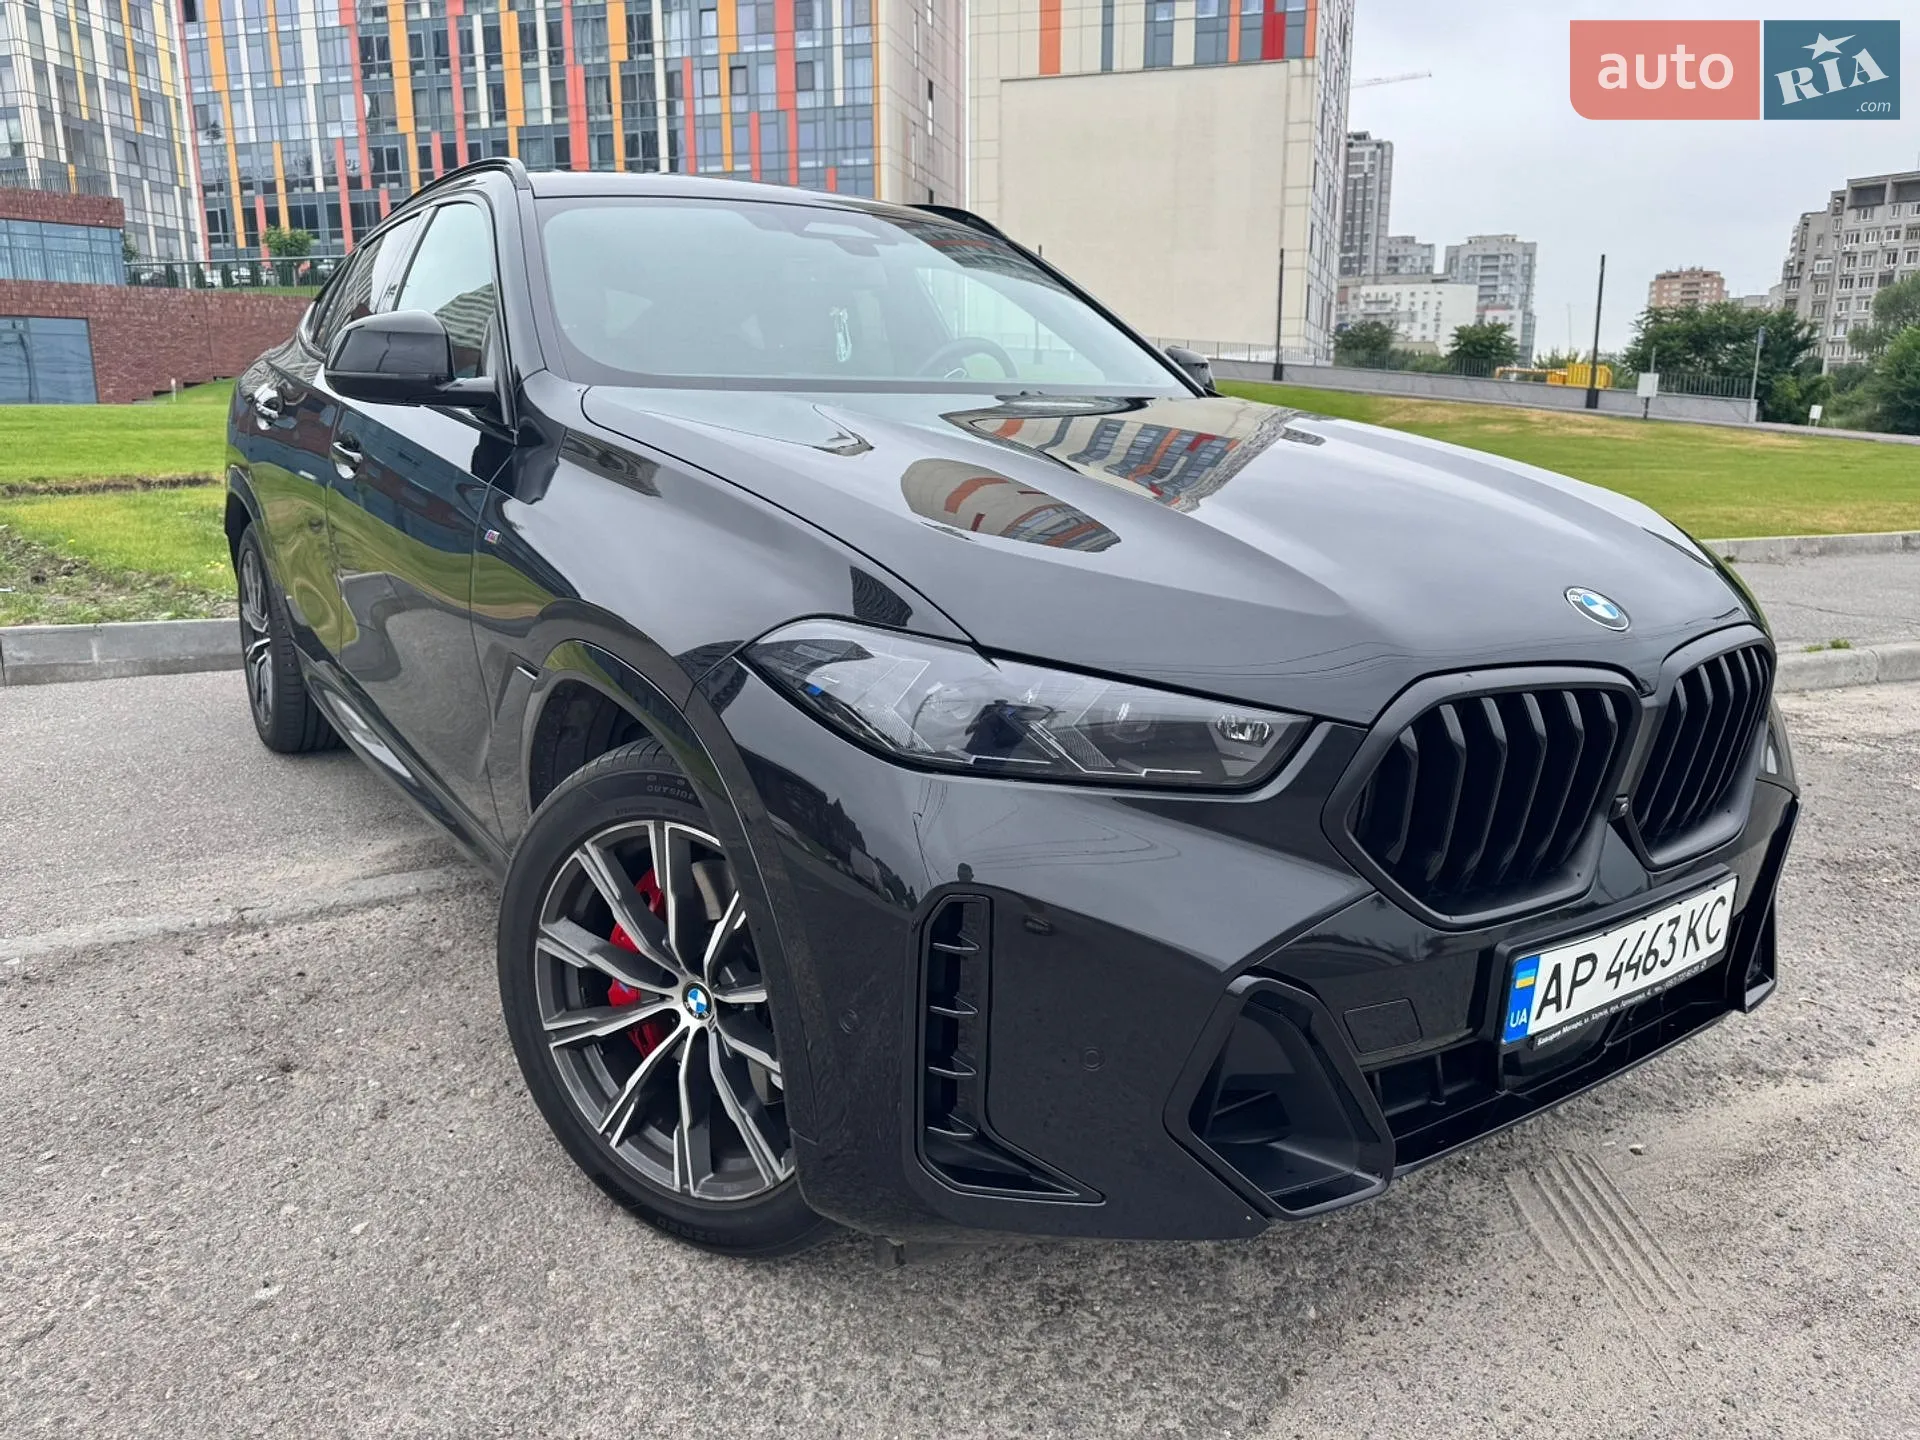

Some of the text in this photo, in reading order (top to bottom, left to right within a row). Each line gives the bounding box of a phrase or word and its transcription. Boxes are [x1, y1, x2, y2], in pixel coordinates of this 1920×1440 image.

[1534, 952, 1598, 1021] AP
[1604, 915, 1681, 990] 4463
[1683, 896, 1726, 960] KC
[1510, 1007, 1528, 1028] UA
